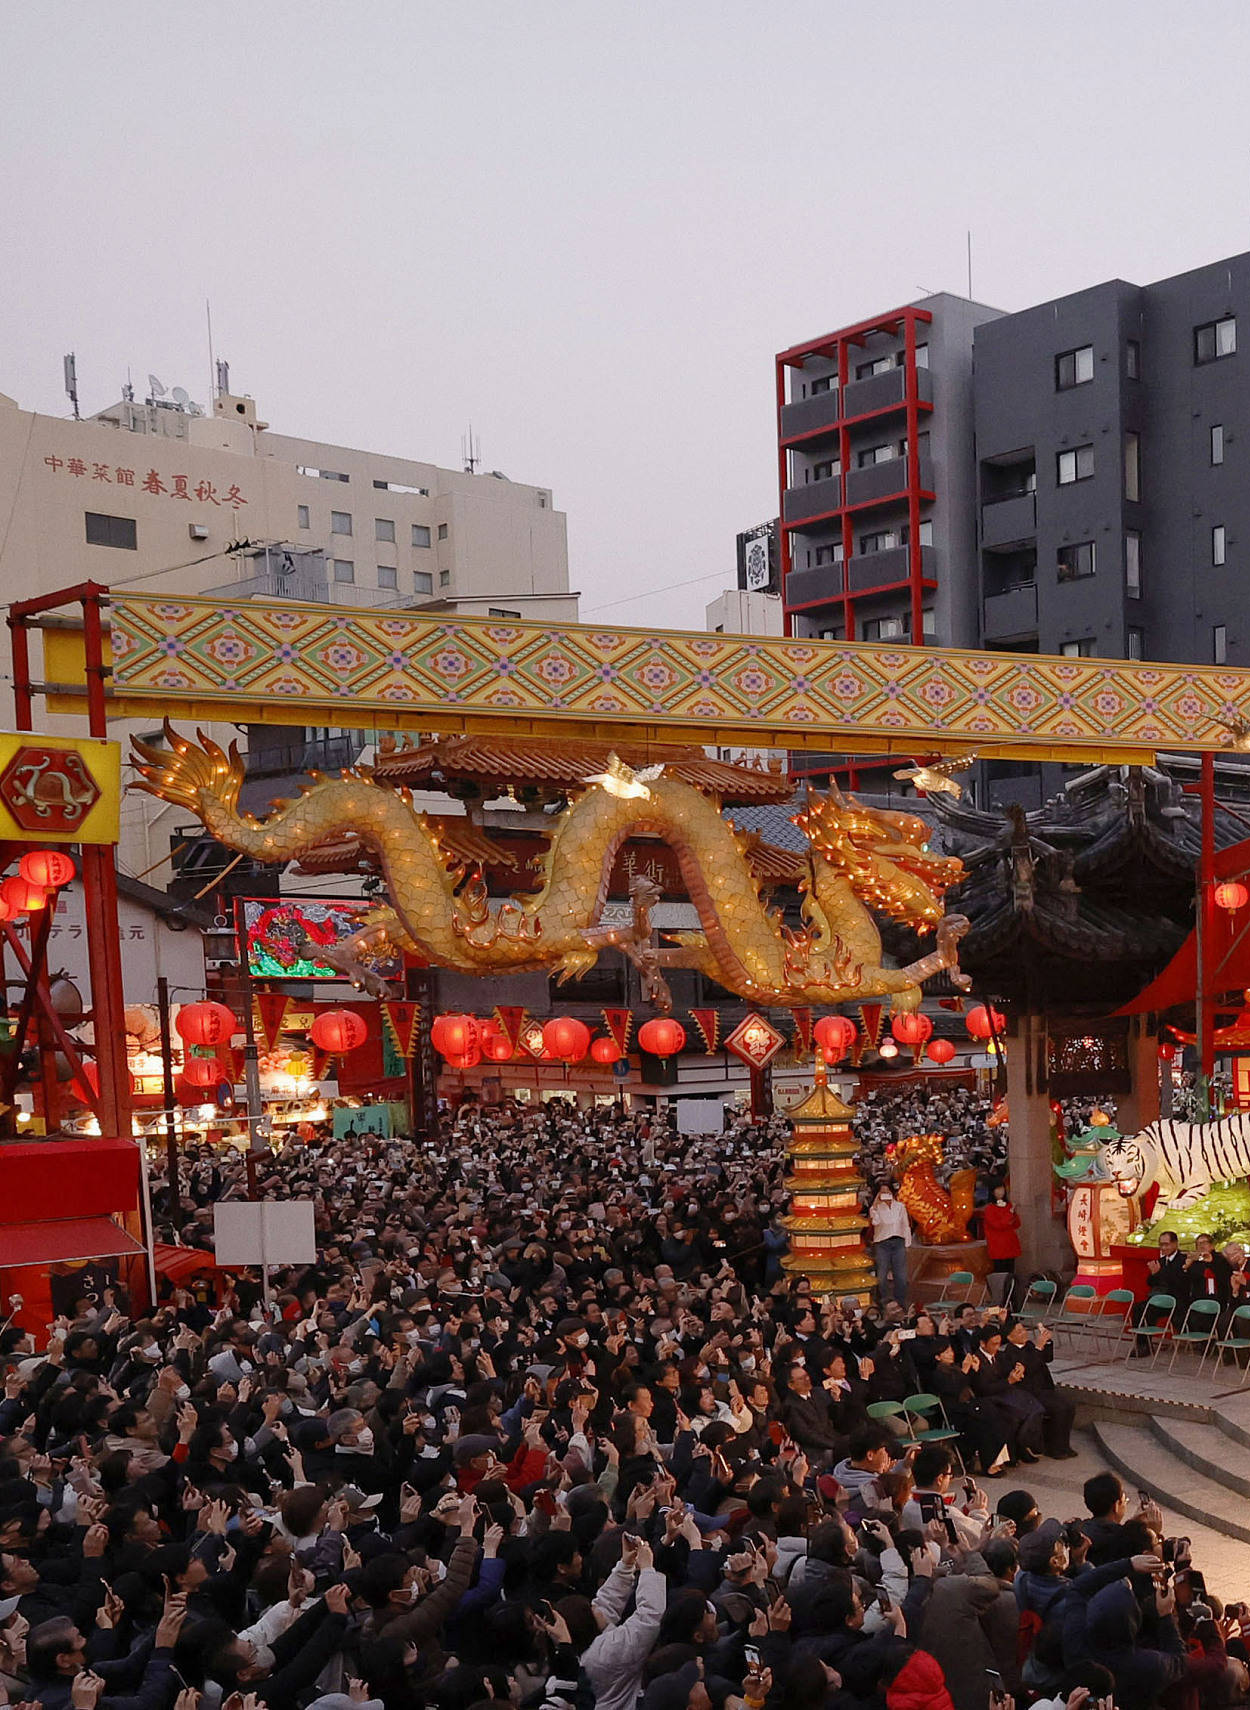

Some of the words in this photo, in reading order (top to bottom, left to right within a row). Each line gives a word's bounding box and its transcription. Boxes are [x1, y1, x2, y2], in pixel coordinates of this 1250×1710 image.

[44, 454, 135, 486] 中華菜館
[141, 468, 248, 509] 春夏秋冬
